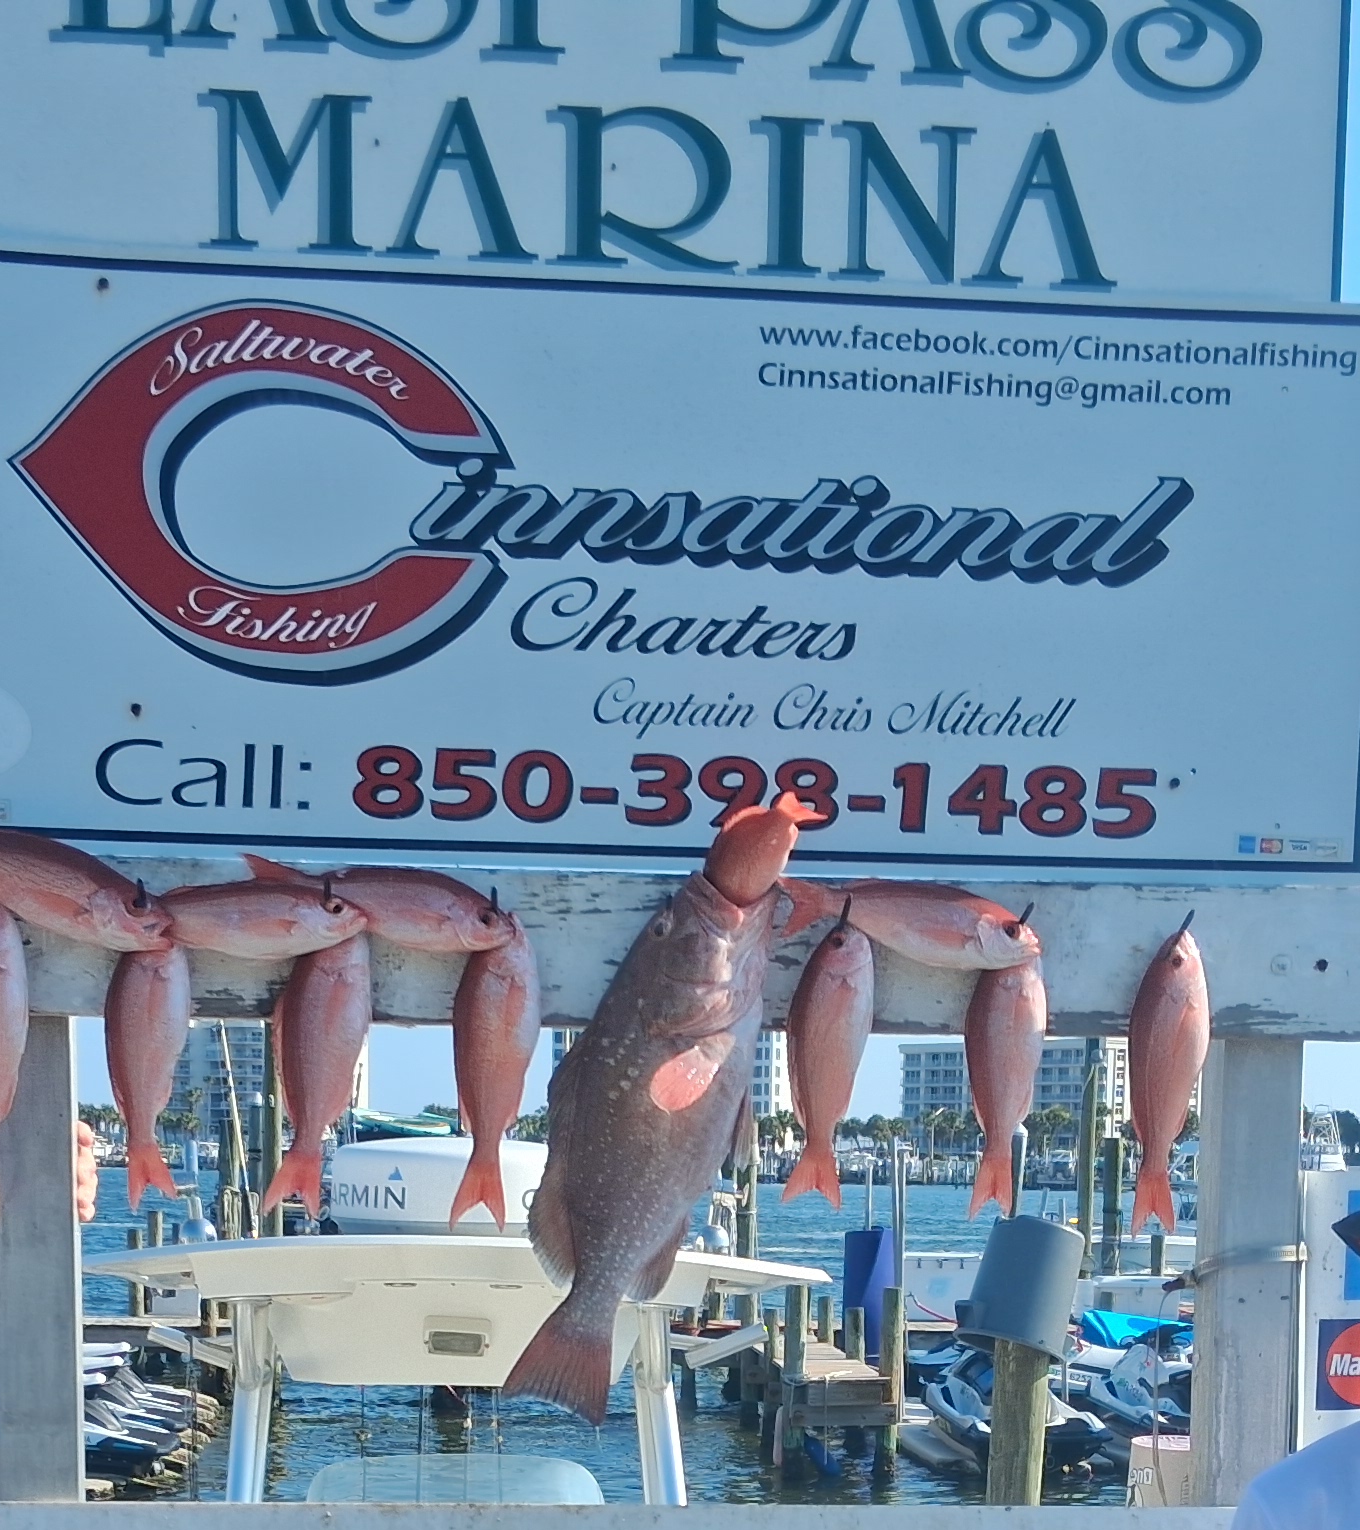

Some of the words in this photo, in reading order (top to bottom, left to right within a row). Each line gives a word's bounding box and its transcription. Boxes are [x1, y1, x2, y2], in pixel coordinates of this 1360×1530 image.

[197, 87, 1118, 292] MARINA
[149, 319, 410, 401] Saltwater
[757, 361, 1233, 409] CinnsationalFishing@gmail.com
[758, 323, 1359, 377] www.facebook.com/Cinnsationalfishing
[8, 296, 1196, 687] Cinnsational
[176, 585, 378, 649] Fishing
[510, 576, 858, 661] Charters
[592, 676, 759, 740] Captain
[772, 683, 873, 735] Chris
[887, 690, 1077, 739] Mitchell
[95, 738, 313, 811] Call:
[352, 744, 1159, 839] 850-398-1485
[330, 1182, 407, 1210] ARMIN
